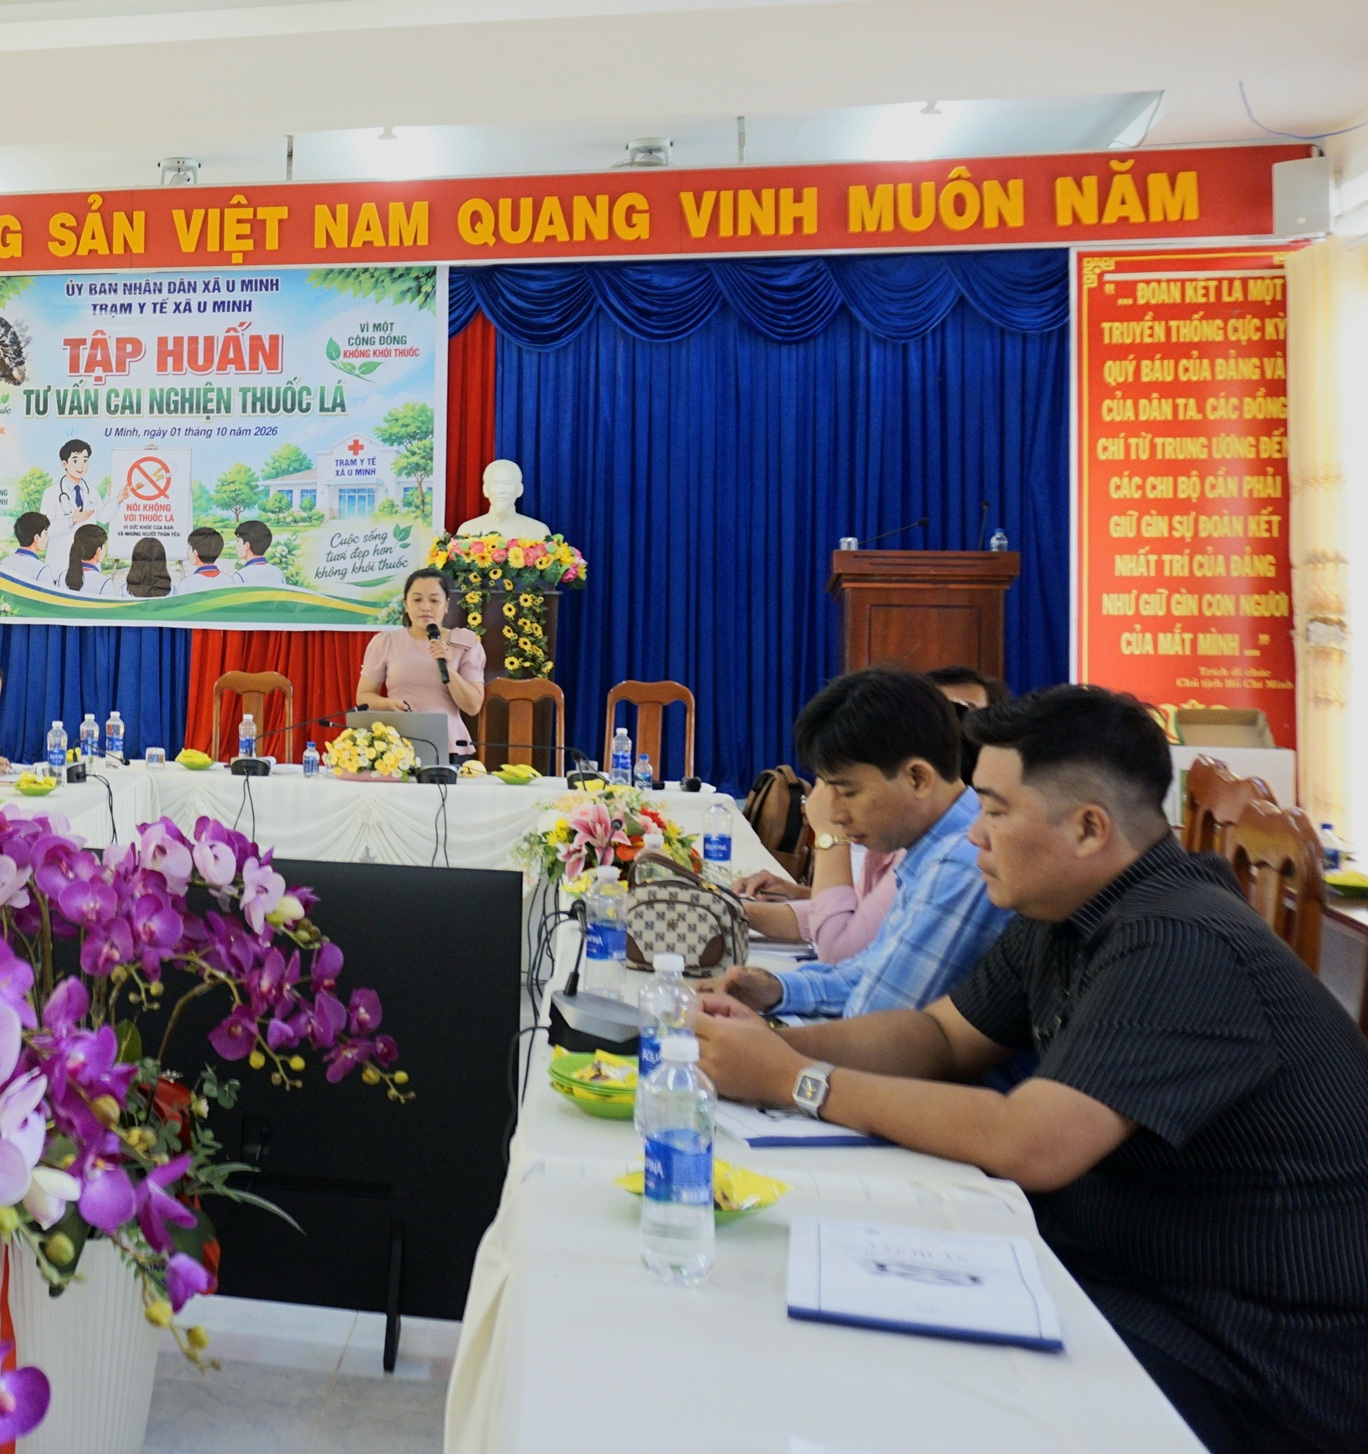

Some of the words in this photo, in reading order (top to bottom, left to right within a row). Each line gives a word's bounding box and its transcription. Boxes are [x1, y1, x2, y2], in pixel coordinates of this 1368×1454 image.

[47, 193, 146, 257] SẢN
[171, 194, 289, 264] VIỆT
[314, 200, 429, 249] NAM
[457, 192, 650, 247] QUANG
[679, 186, 818, 239] VINH
[847, 165, 1025, 234] MUÔN
[1054, 158, 1200, 227] NĂM
[65, 279, 84, 297] ỦY
[88, 281, 119, 296] BAN
[122, 278, 163, 295] NHÂN
[167, 278, 198, 294] DÂN
[201, 277, 222, 294] XÃ
[226, 280, 236, 293] U
[240, 278, 280, 292] MINH
[91, 302, 133, 318] TRẠM
[138, 301, 147, 315] Y
[151, 297, 169, 315] TẾ
[172, 298, 193, 314] XÃ
[197, 300, 208, 314] U
[212, 299, 253, 313] MINH
[360, 321, 369, 333] VÌ
[373, 321, 395, 334] MỘT
[1101, 311, 1166, 344] TRUYỀN
[1168, 311, 1224, 343] THỐNG
[1227, 314, 1261, 345] CỰC
[63, 330, 144, 383] TẬP
[156, 321, 283, 373] HUẤN
[373, 347, 392, 358] KHÓI
[394, 345, 420, 357] THUỐC
[1103, 355, 1136, 386] QUÝ
[1140, 354, 1175, 382] BÁU
[1178, 350, 1212, 382] CỦA
[1214, 350, 1261, 381] ĐẢNG
[1262, 351, 1286, 380] VÀ
[23, 384, 51, 416] TƯ
[55, 380, 100, 416] VẤN
[105, 388, 142, 415] CAI
[148, 381, 232, 420] NGHIỆN
[238, 377, 313, 415] THUỐC
[319, 380, 347, 413] LÁ
[1101, 391, 1135, 422] CỦA
[1138, 393, 1173, 421] DÂN
[1205, 391, 1240, 420] CÁC
[104, 427, 113, 437] U
[114, 426, 141, 439] Minh,
[143, 427, 168, 440] ngày
[170, 427, 181, 437] 01
[184, 426, 213, 439] tháng
[216, 427, 227, 437] 10
[229, 427, 252, 437] năm
[254, 426, 278, 436] 2026
[1096, 432, 1126, 460] CHÍ
[1127, 432, 1152, 460] TỪ
[1153, 436, 1209, 460] TRUNG
[1211, 434, 1257, 459] ƯƠNG
[335, 458, 357, 468] TRẠM
[367, 456, 376, 465] TẾ
[355, 468, 376, 476] MINH
[1109, 471, 1143, 499] CÁC
[1145, 475, 1174, 499] CHI
[1177, 470, 1202, 503] BỘ
[1204, 467, 1238, 499] CẦN
[1243, 467, 1282, 499] PHẢI
[330, 533, 360, 548] Cuộc
[363, 528, 388, 545] sống
[1109, 510, 1139, 538] GIỮ
[1140, 510, 1169, 538] GÌN
[1172, 511, 1196, 543] SỰ
[1198, 510, 1243, 538] ĐOÀN
[1247, 507, 1282, 538] KẾT
[314, 563, 348, 580] không
[351, 559, 376, 574] khói
[378, 555, 409, 570] thuốc
[325, 550, 348, 563] tươi
[350, 546, 370, 565] đẹp
[373, 544, 394, 556] hơn
[1114, 546, 1159, 577] NHẤT
[1161, 549, 1190, 577] TRÍ
[1192, 546, 1226, 577] CỦA
[1230, 546, 1276, 578] ĐẢNG
[1102, 589, 1138, 616] NHƯ
[1120, 623, 1154, 655] CỦA
[1157, 623, 1193, 655] MẮT
[1197, 627, 1240, 656] MÌNH
